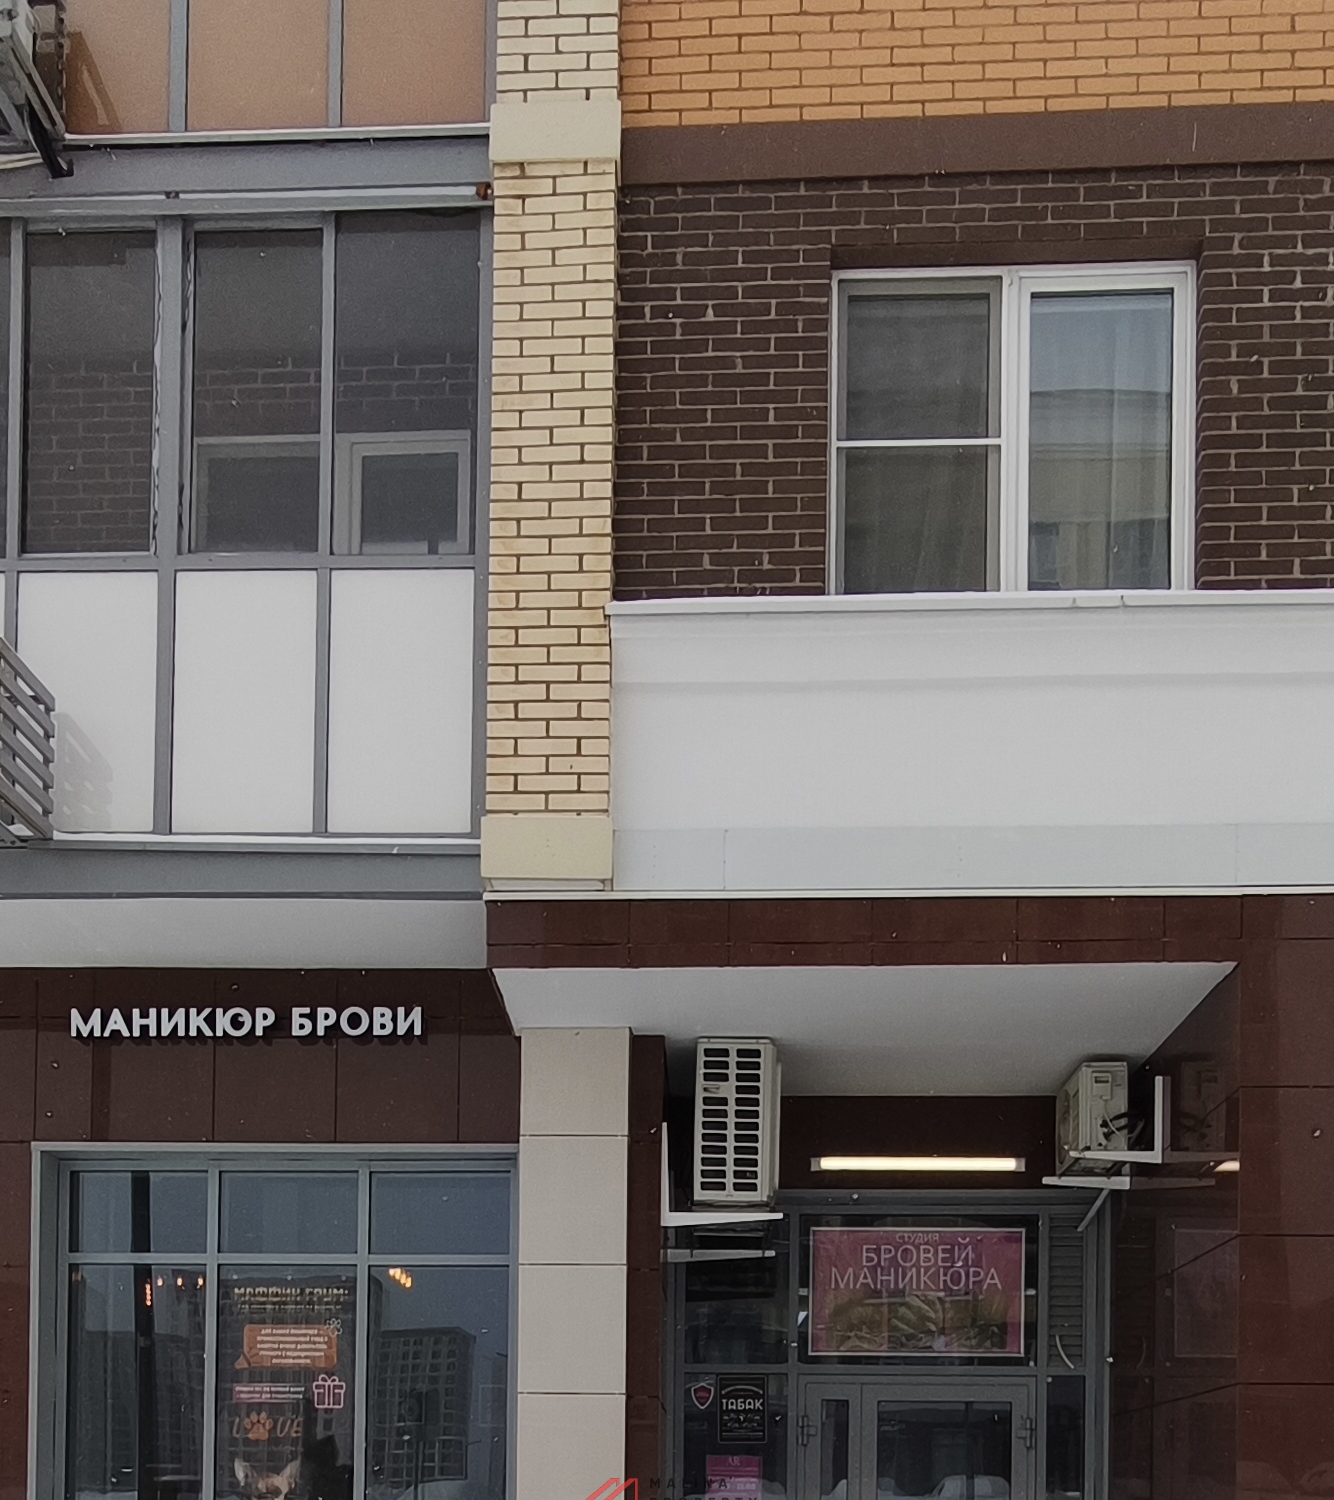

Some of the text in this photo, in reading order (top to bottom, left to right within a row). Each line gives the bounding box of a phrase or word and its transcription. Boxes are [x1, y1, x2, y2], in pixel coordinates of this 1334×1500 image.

[70, 1006, 422, 1037] МАНИКЮР БРОВИ
[896, 1233, 940, 1244] СТУДИЯ
[862, 1237, 973, 1266] БРОВЕЙ
[830, 1266, 1002, 1289] МАНИКЮРА
[721, 1399, 763, 1411] ТАБАК
